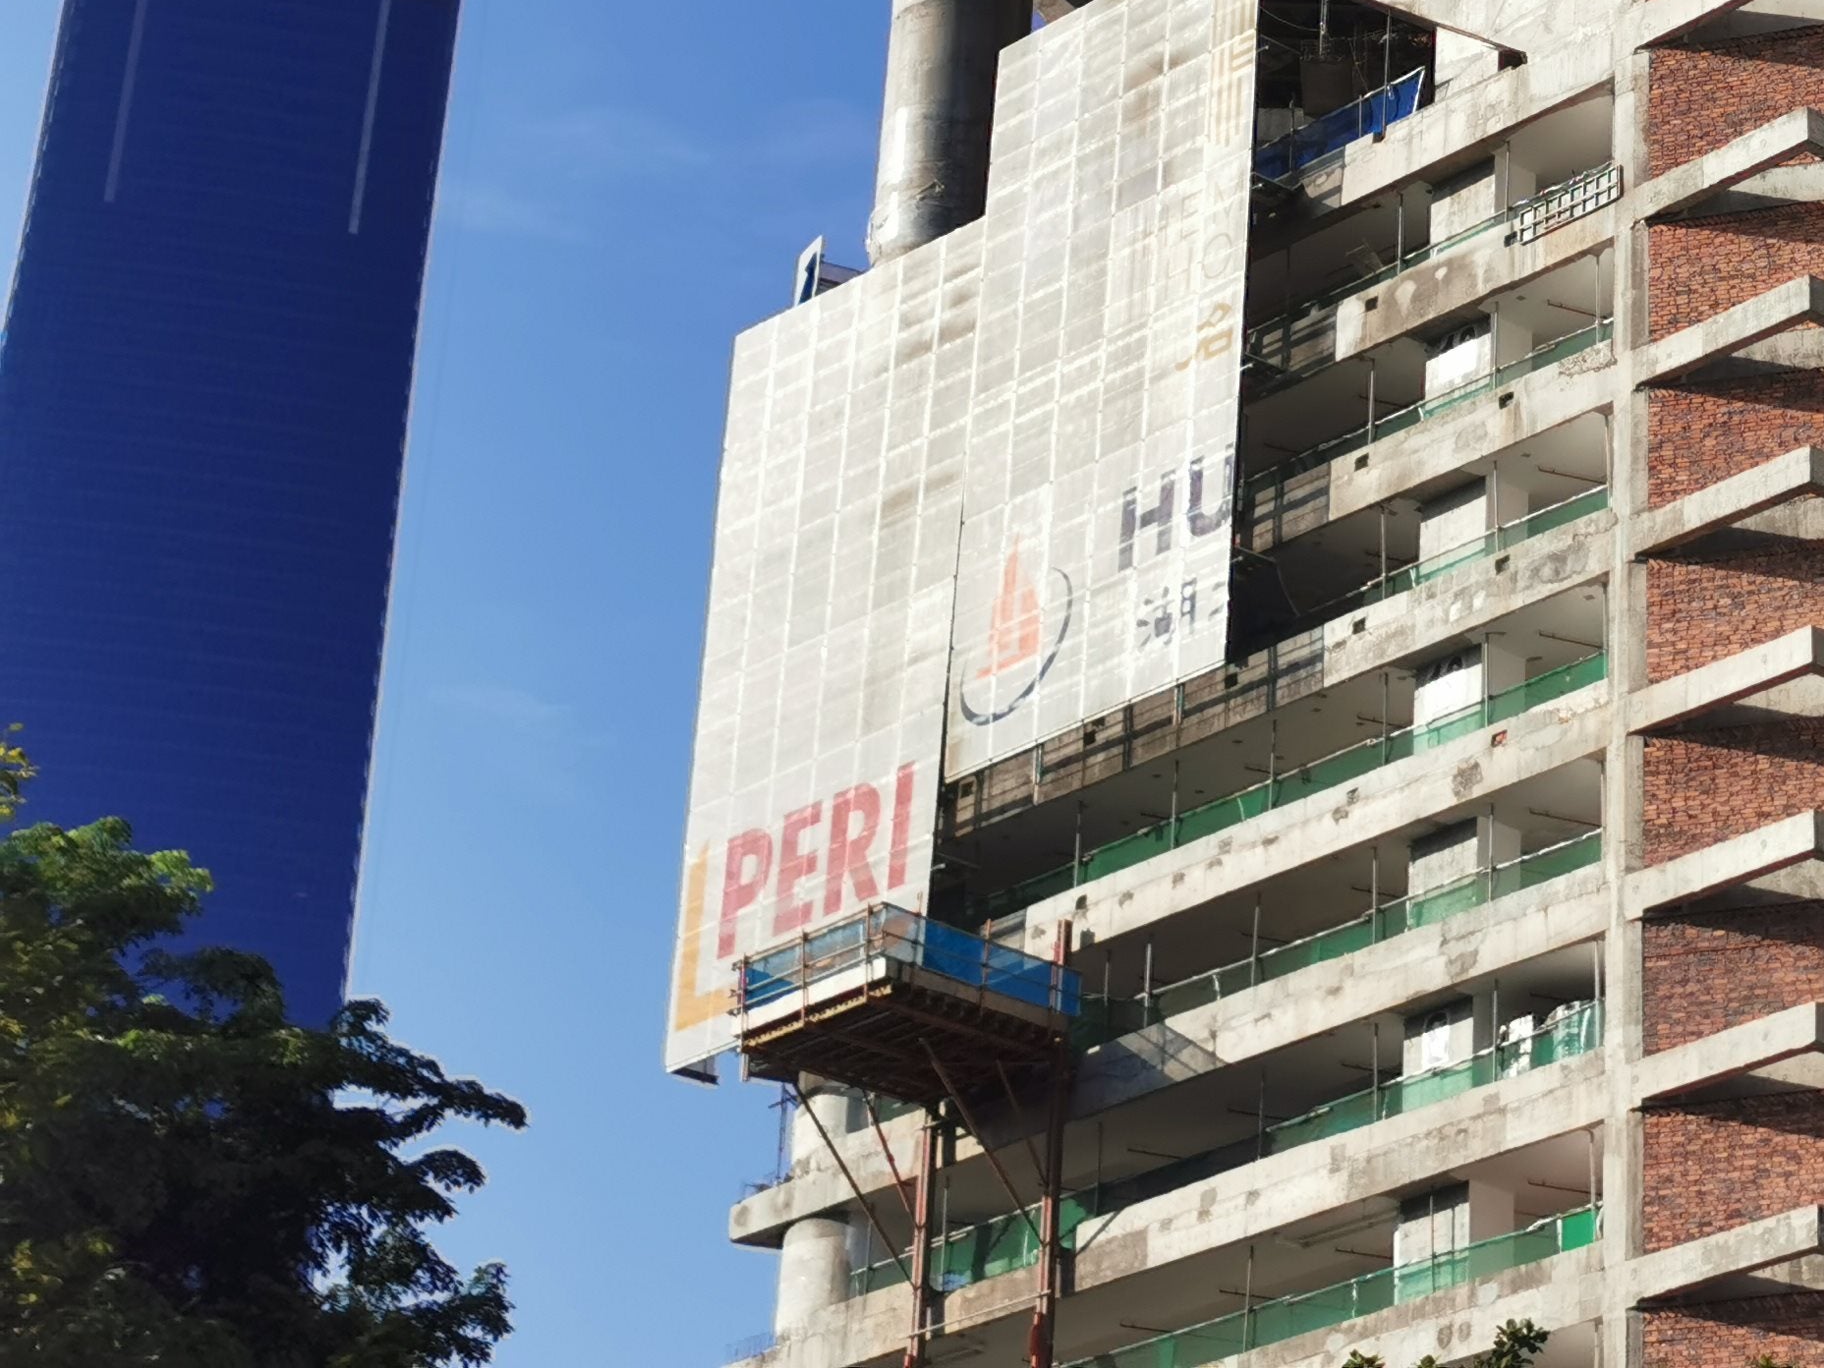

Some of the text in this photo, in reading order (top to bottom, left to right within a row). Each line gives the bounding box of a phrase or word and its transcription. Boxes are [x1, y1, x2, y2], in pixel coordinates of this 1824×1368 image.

[1118, 443, 1234, 573] HU
[1135, 576, 1227, 649] 湖
[717, 761, 914, 959] PERI
